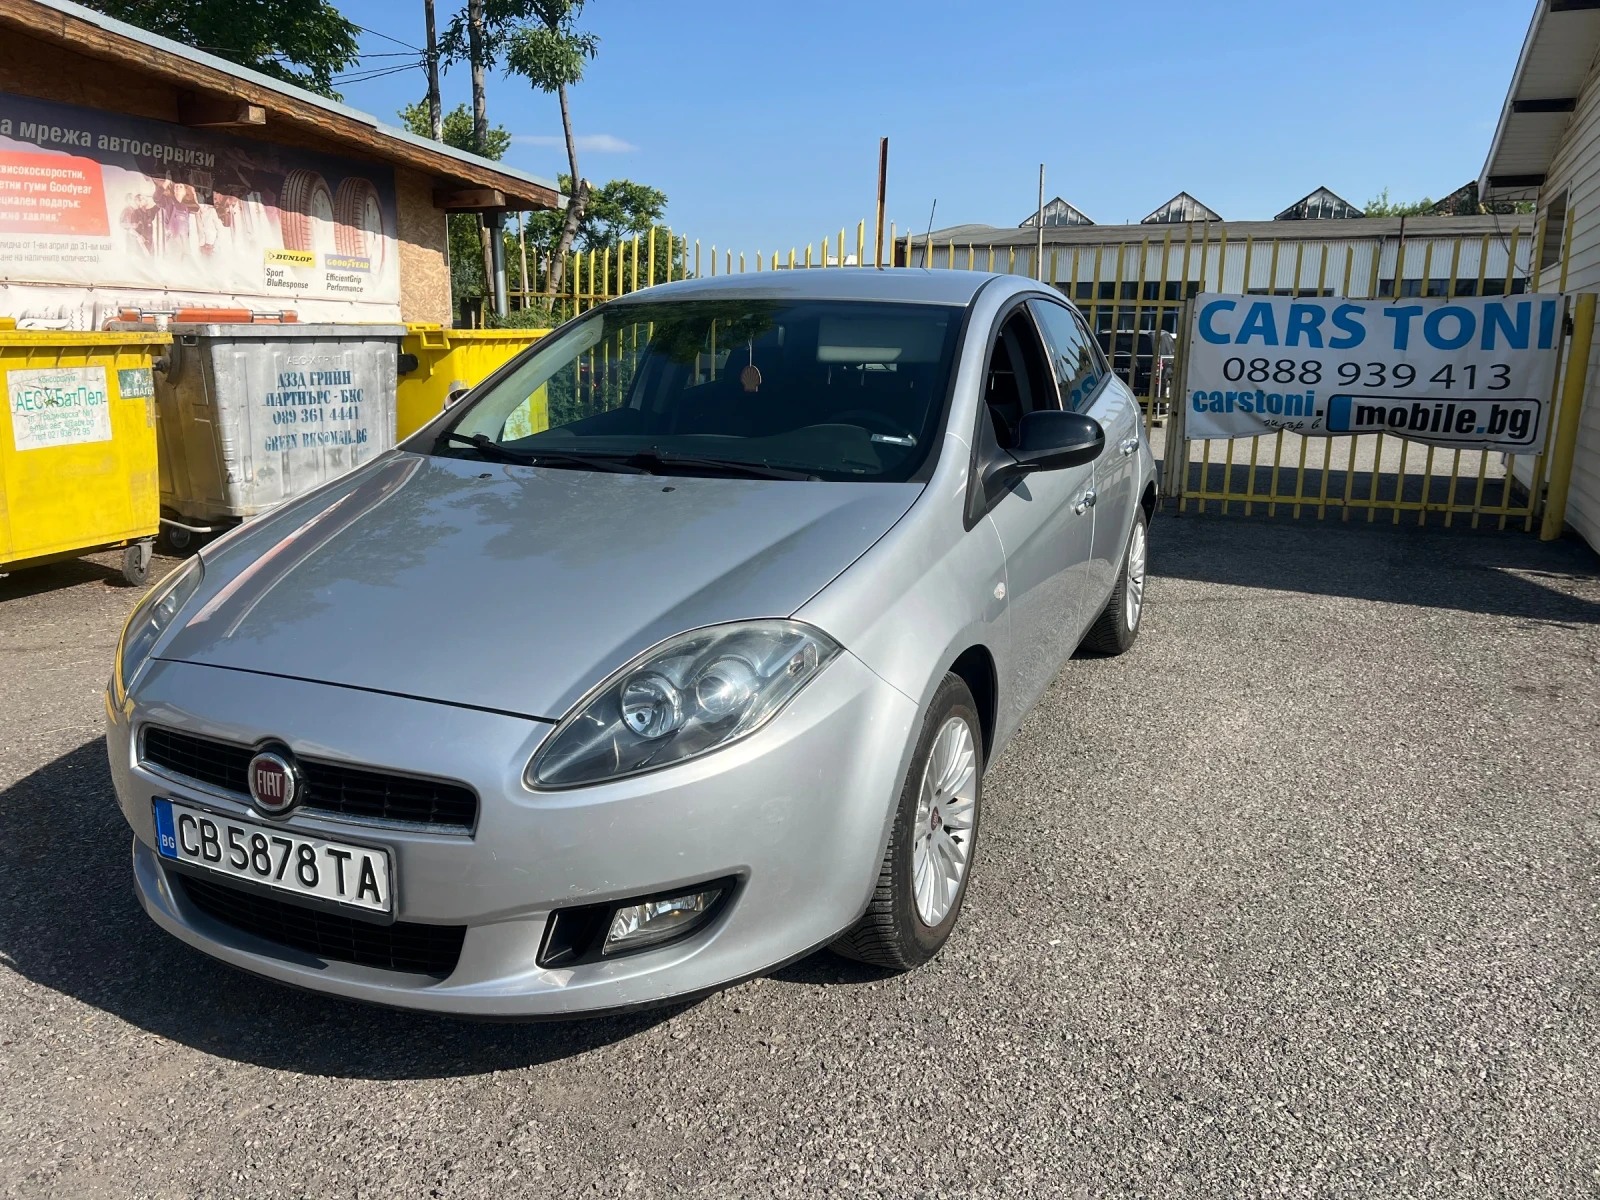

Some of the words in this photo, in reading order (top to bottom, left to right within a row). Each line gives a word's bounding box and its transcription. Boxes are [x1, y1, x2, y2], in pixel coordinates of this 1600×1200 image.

[20, 122, 92, 148] мрежа
[98, 134, 215, 168] автосервизи
[0, 164, 86, 180] високоскоростни,
[24, 182, 47, 193] гуми
[50, 181, 92, 196] Goodyear
[0, 195, 37, 206] циален
[22, 240, 30, 248] от
[48, 242, 68, 251] април
[14, 254, 22, 262] на
[276, 254, 312, 262] DUNLOP
[326, 258, 370, 269] GOODYEAR
[266, 268, 284, 278] Sport
[326, 273, 362, 284] EfficientGrip
[266, 278, 309, 290] BluResponse
[326, 282, 364, 293] Performance
[1198, 300, 1366, 350] CARS
[1384, 300, 1556, 352] TONI
[310, 368, 352, 386] ГРИЙН
[1222, 357, 1322, 386] 0888
[1337, 362, 1417, 388] 939
[1429, 363, 1512, 391] 413
[120, 388, 132, 396] НЕ
[266, 390, 332, 406] ПАРТНЪРС
[340, 388, 364, 404] БКС
[272, 410, 296, 425] 089
[301, 408, 324, 422] 361
[329, 406, 359, 420] 4441
[1355, 402, 1532, 440] mobile.bg
[48, 431, 56, 439] 02
[256, 768, 283, 798] FIAT
[161, 833, 176, 850] BG
